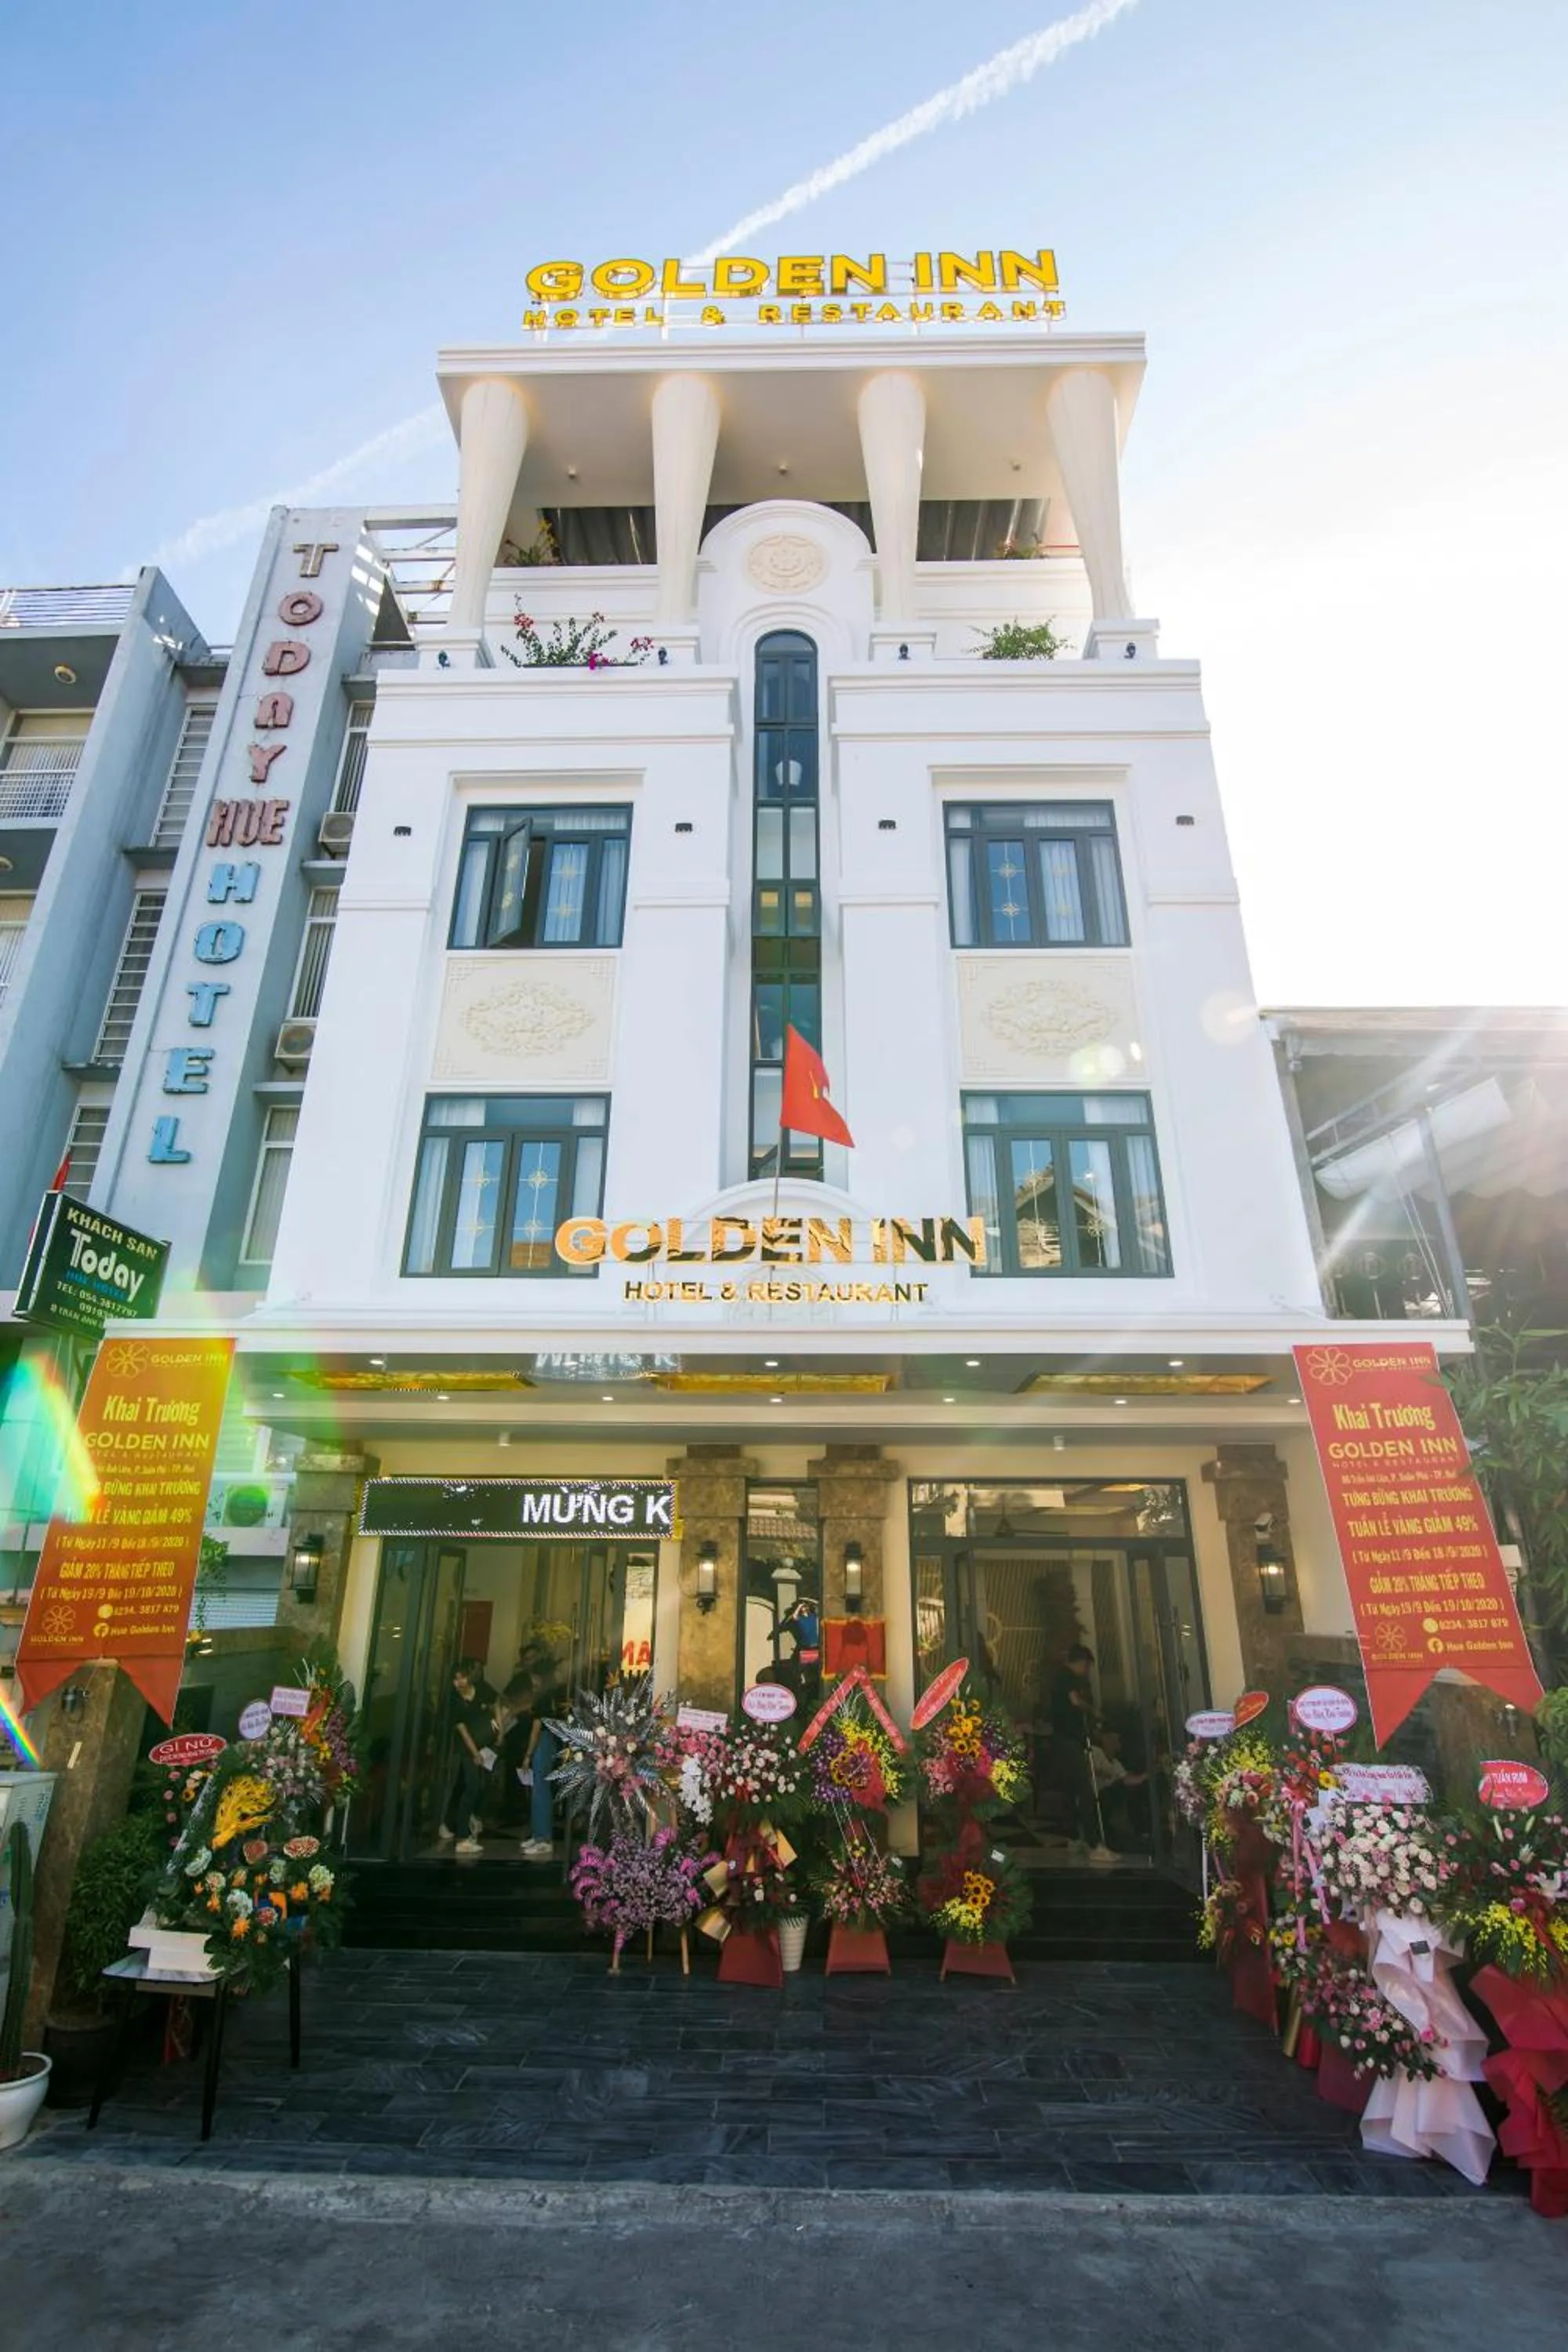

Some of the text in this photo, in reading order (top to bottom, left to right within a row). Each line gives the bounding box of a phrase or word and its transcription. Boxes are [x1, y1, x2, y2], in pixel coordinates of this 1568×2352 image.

[524, 249, 1059, 301] GOLDEN INN
[523, 301, 1067, 329] HOTEL & RESTAURANT
[148, 543, 339, 1163] TODAY HUE HOTEL
[554, 1215, 987, 1266] GOLDEN INN
[70, 1229, 145, 1302] Today
[624, 1281, 929, 1302] HOTEL & RESTAURANT
[151, 1354, 201, 1363] GOLDEN
[1352, 1356, 1431, 1368] GOLDEN INN
[102, 1395, 142, 1421] Khai
[1332, 1403, 1370, 1431] Khai
[85, 1432, 211, 1450] GOLDEN INN
[1328, 1437, 1458, 1459] GOLDEN INN
[169, 1507, 194, 1524] 49%
[522, 1486, 670, 1524] MỪNG K
[1454, 1514, 1479, 1532] 49%
